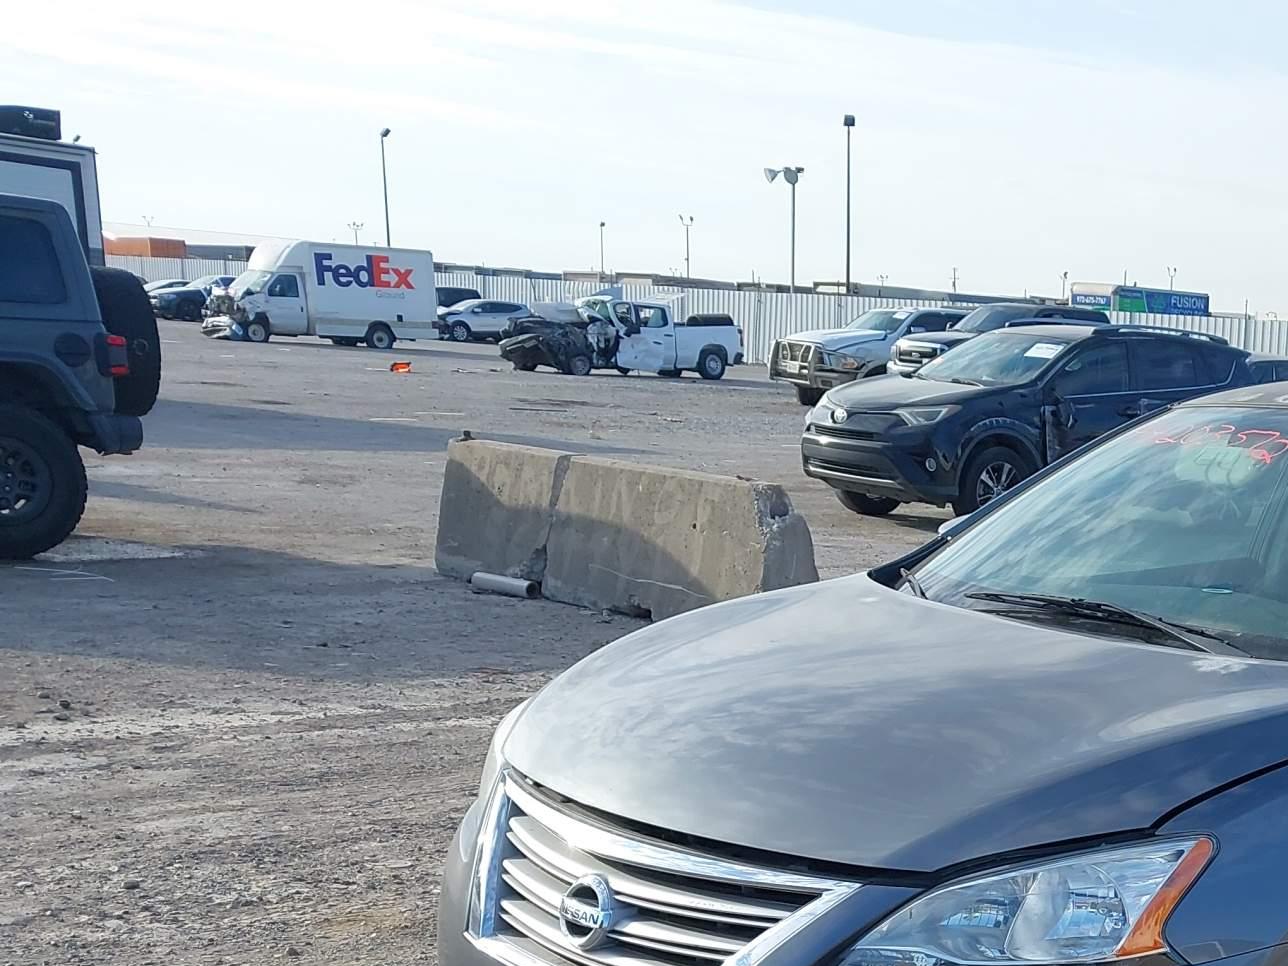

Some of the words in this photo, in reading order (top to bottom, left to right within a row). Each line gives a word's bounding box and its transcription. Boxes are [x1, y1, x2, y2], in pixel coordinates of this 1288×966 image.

[314, 252, 416, 289] FedEx
[1171, 295, 1205, 309] FUSION
[561, 897, 600, 925] NISSAN
